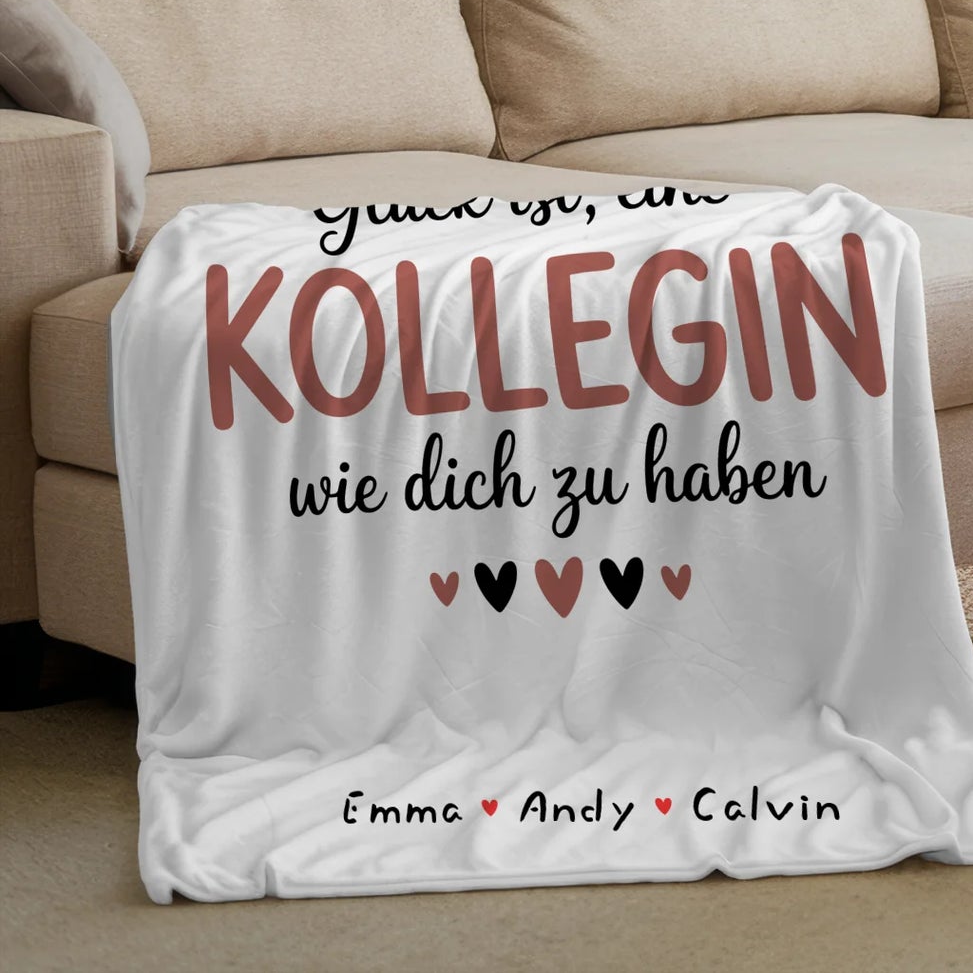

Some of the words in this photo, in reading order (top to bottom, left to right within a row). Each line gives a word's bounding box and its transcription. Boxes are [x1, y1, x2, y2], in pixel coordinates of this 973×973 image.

[205, 233, 887, 430] KOLLEGIN
[289, 461, 389, 518] wie
[404, 428, 537, 512] dich
[551, 466, 630, 539] zu
[644, 419, 828, 505] haben
[343, 790, 464, 825] Emma
[518, 788, 635, 832] Andy
[692, 785, 841, 822] Calvin
